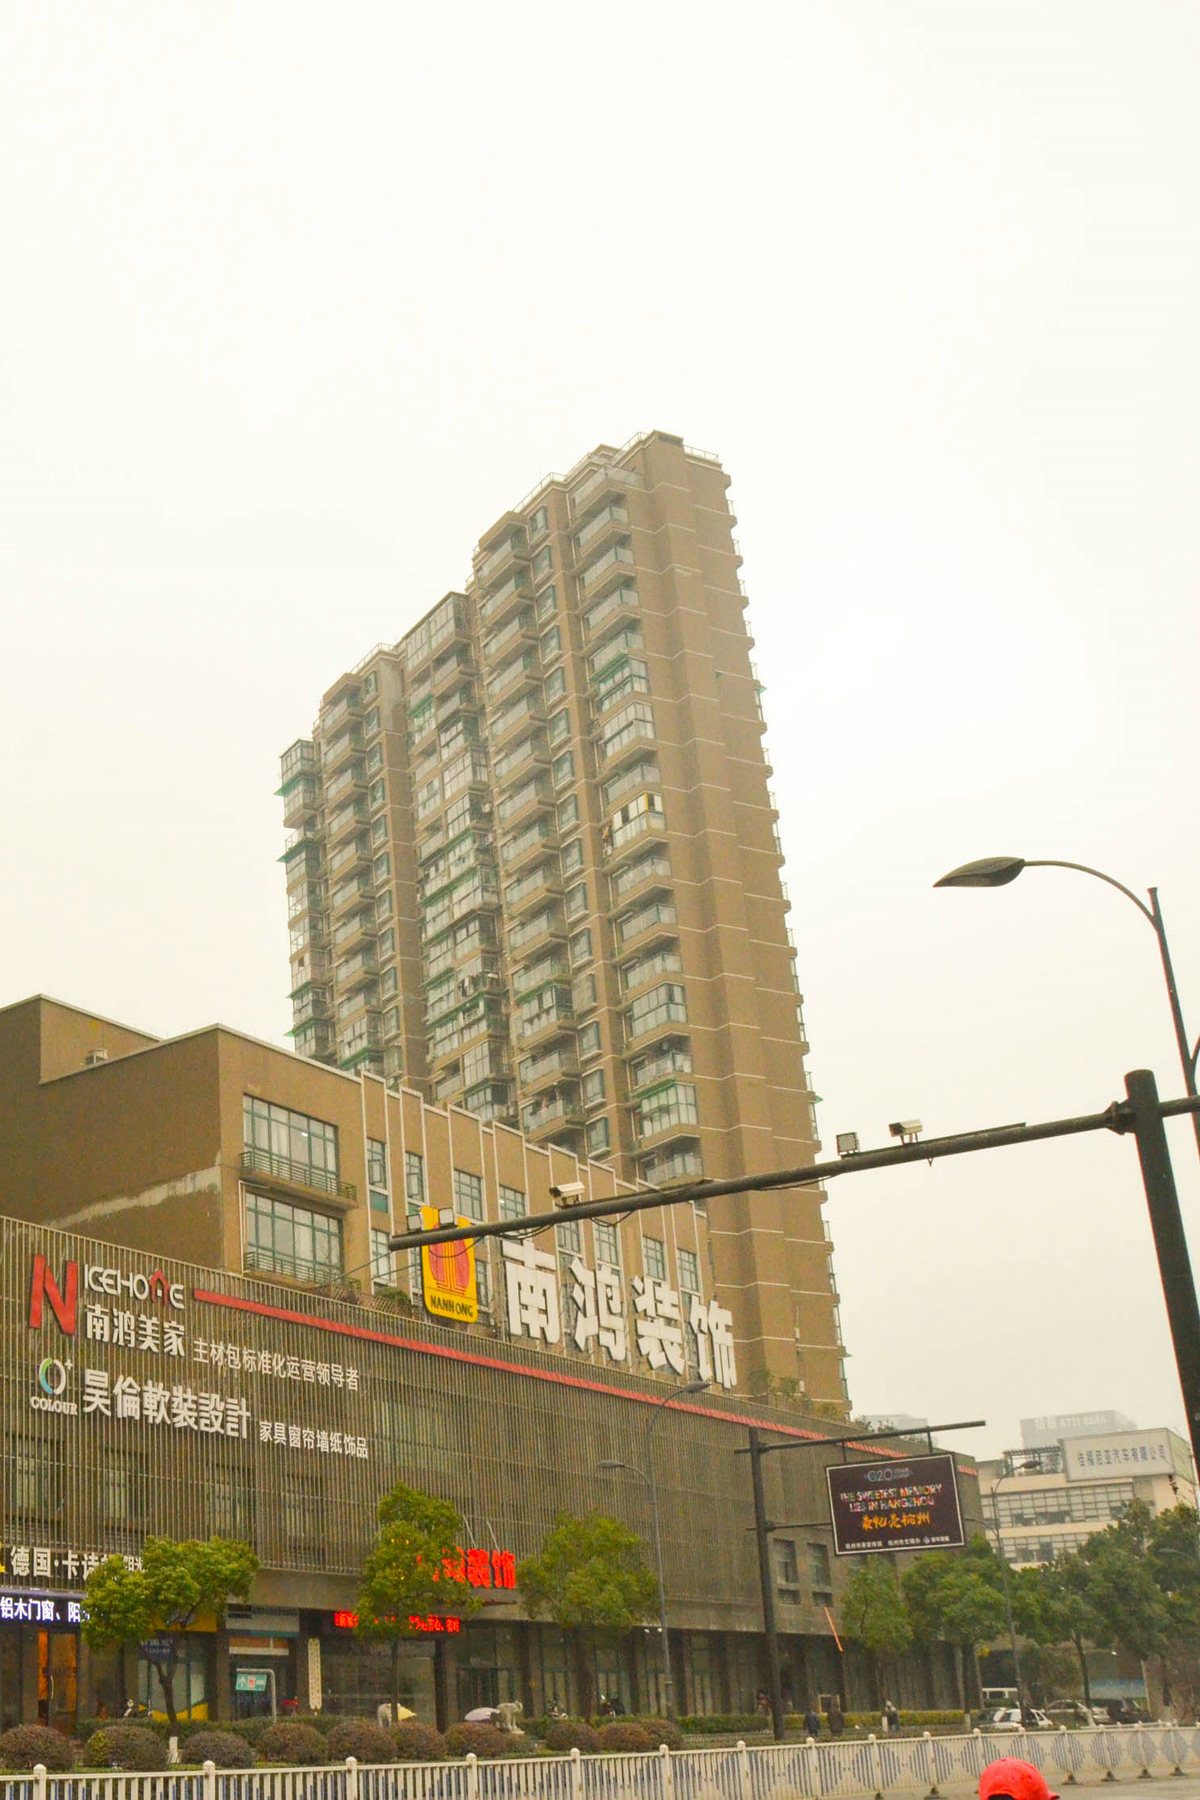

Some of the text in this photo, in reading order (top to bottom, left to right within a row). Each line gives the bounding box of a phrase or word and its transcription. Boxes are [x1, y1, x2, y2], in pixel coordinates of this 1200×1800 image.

[85, 1303, 186, 1357] 南鸿美家
[501, 1239, 738, 1389] 南鸿装饰
[193, 1337, 360, 1392] 主材包标准化运营领导者
[30, 1396, 78, 1416] COLOUR
[259, 1420, 369, 1459] 家具窗帘墙纸饰品
[880, 1495, 935, 1510] HANGZHOU
